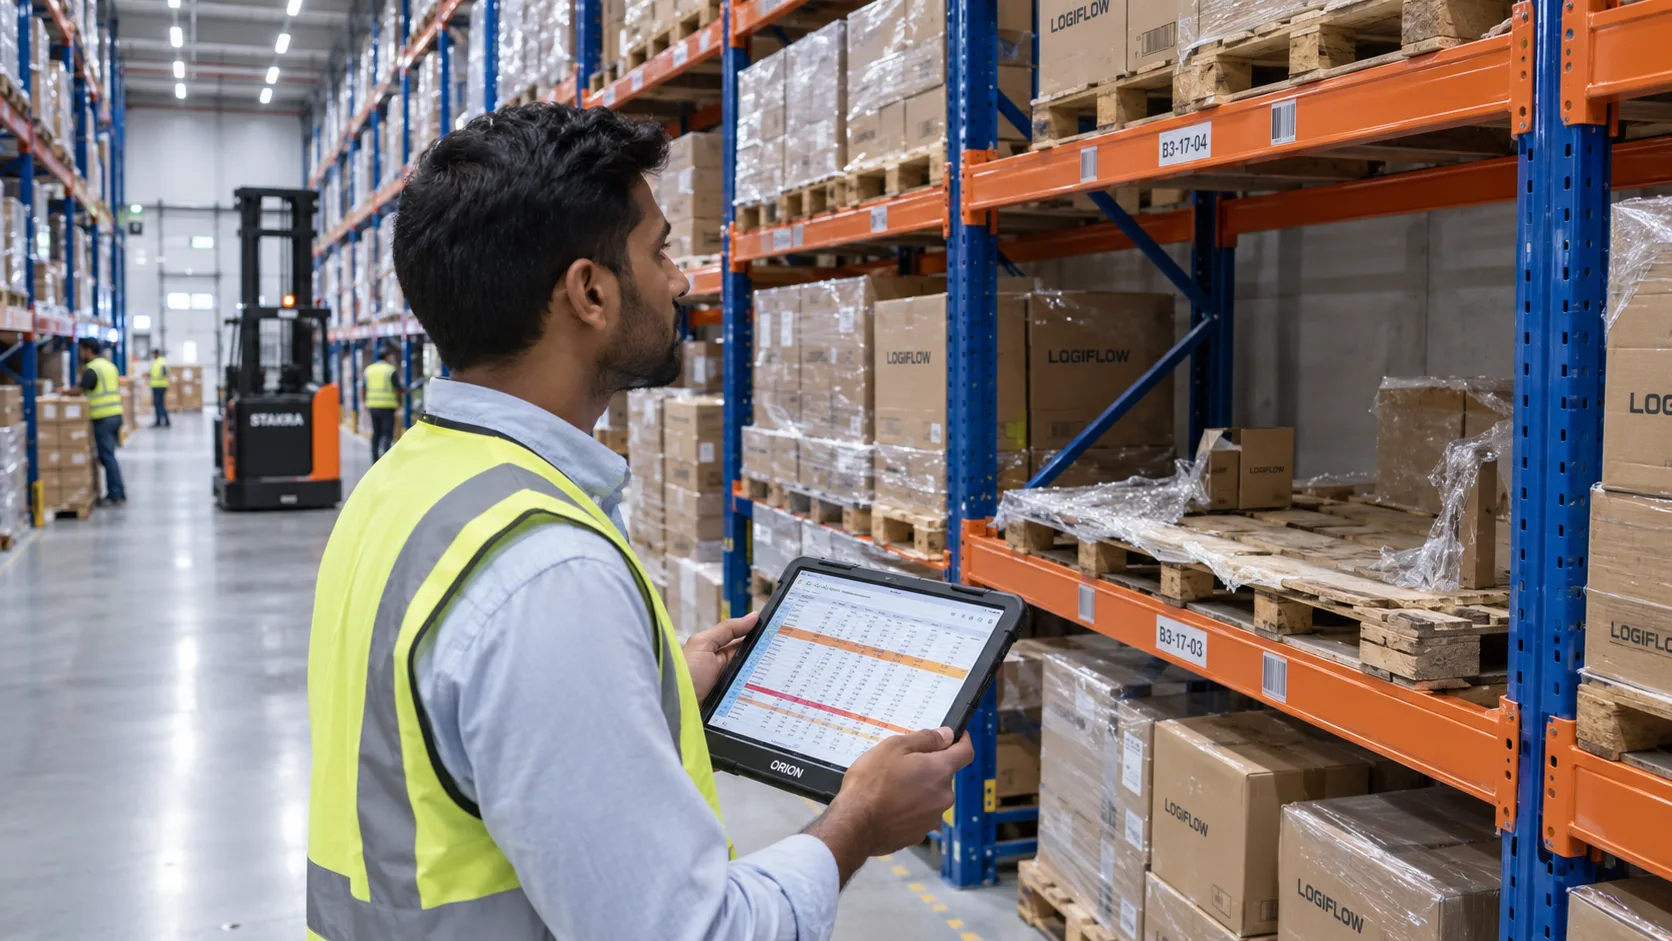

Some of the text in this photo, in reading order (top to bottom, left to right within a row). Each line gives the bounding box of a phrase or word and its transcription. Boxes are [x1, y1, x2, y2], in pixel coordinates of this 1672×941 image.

[1050, 0, 1110, 33] LOGIFLOW
[1162, 134, 1207, 159] B3-17-04
[886, 351, 931, 365] LOGIFLOW
[1048, 350, 1130, 364] LOGIFLOW
[1160, 626, 1203, 658] B3-17-03
[770, 760, 804, 778] ORION
[1164, 798, 1209, 837] LOGIFLOW
[1298, 878, 1364, 934] LOGIFLOW
